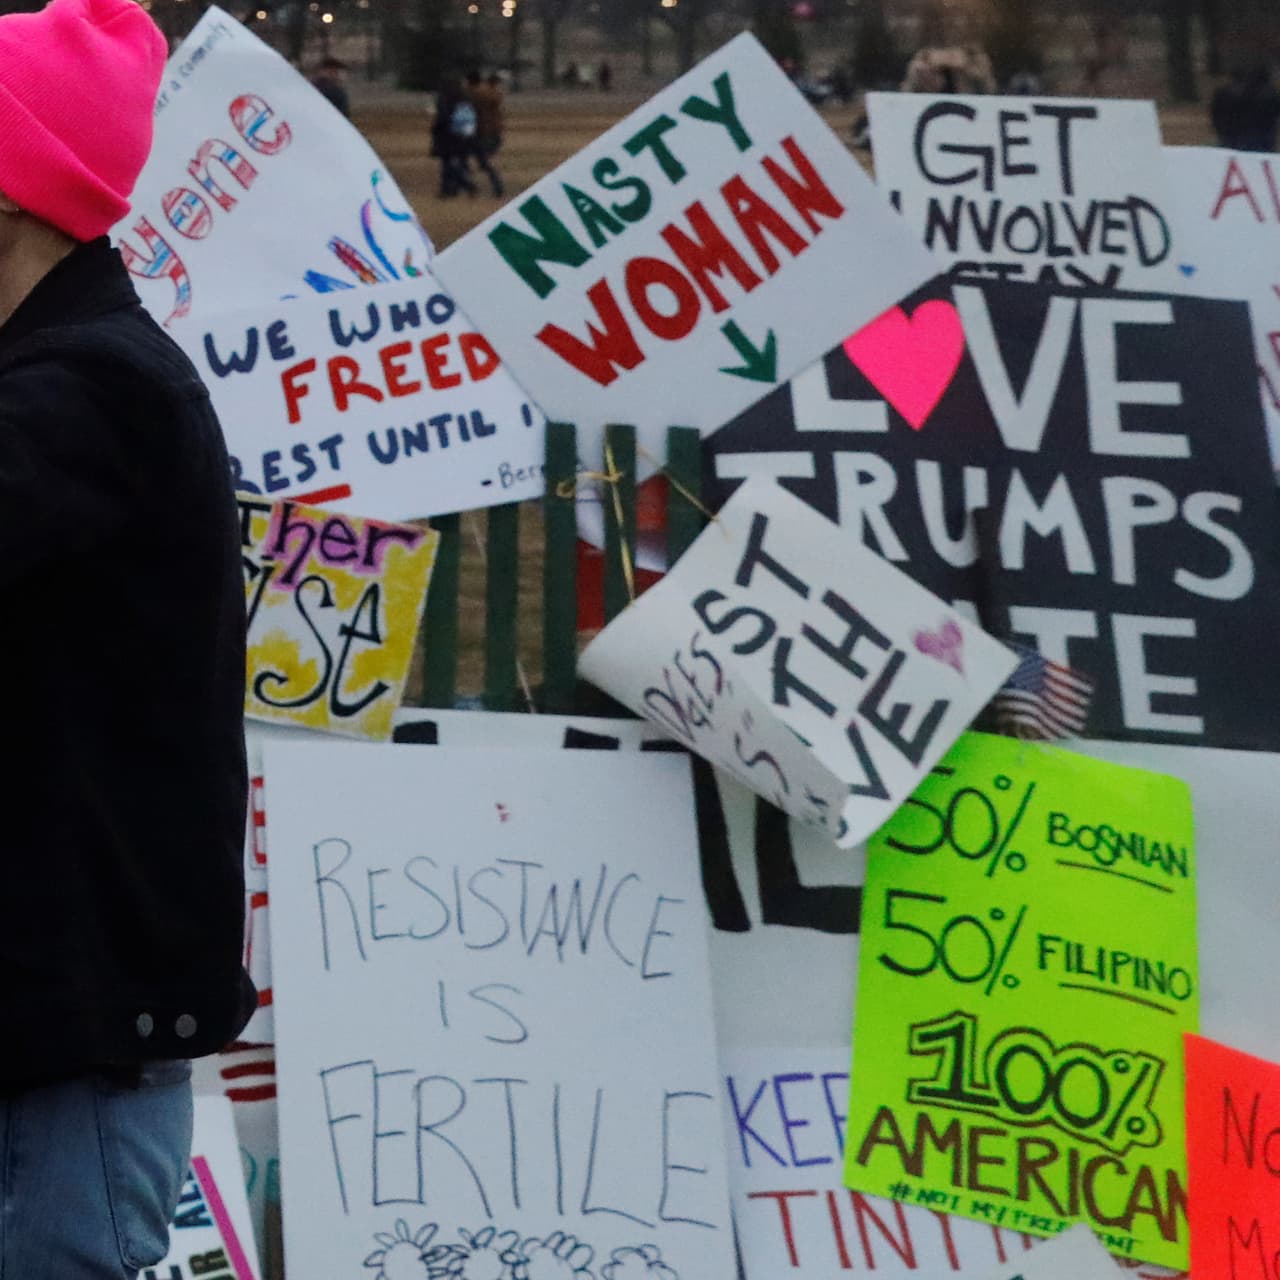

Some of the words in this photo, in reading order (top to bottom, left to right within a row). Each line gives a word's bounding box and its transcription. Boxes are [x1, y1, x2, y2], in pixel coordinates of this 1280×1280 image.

[116, 93, 293, 327] yone
[487, 70, 754, 300] NASTY
[913, 100, 1098, 197] GET
[533, 133, 847, 389] WOMAN
[203, 320, 297, 379] WE
[327, 293, 457, 349] WHO
[279, 331, 503, 424] FREED
[367, 409, 498, 467] UNTIL
[714, 450, 1255, 601] TRUMPS
[952, 599, 1205, 735] TE
[885, 766, 1037, 879] 50%
[1046, 810, 1191, 879] BOSNIAN
[312, 836, 686, 981] RESISTANCE
[877, 887, 1029, 996] 50%
[1036, 932, 1193, 1001] FILIPINO
[438, 979, 529, 1045] IS
[318, 1059, 719, 1230] FERTILE
[726, 1072, 851, 1170] KEE
[906, 1008, 1168, 1156] 100%
[855, 1104, 1190, 1243] AMERICAN
